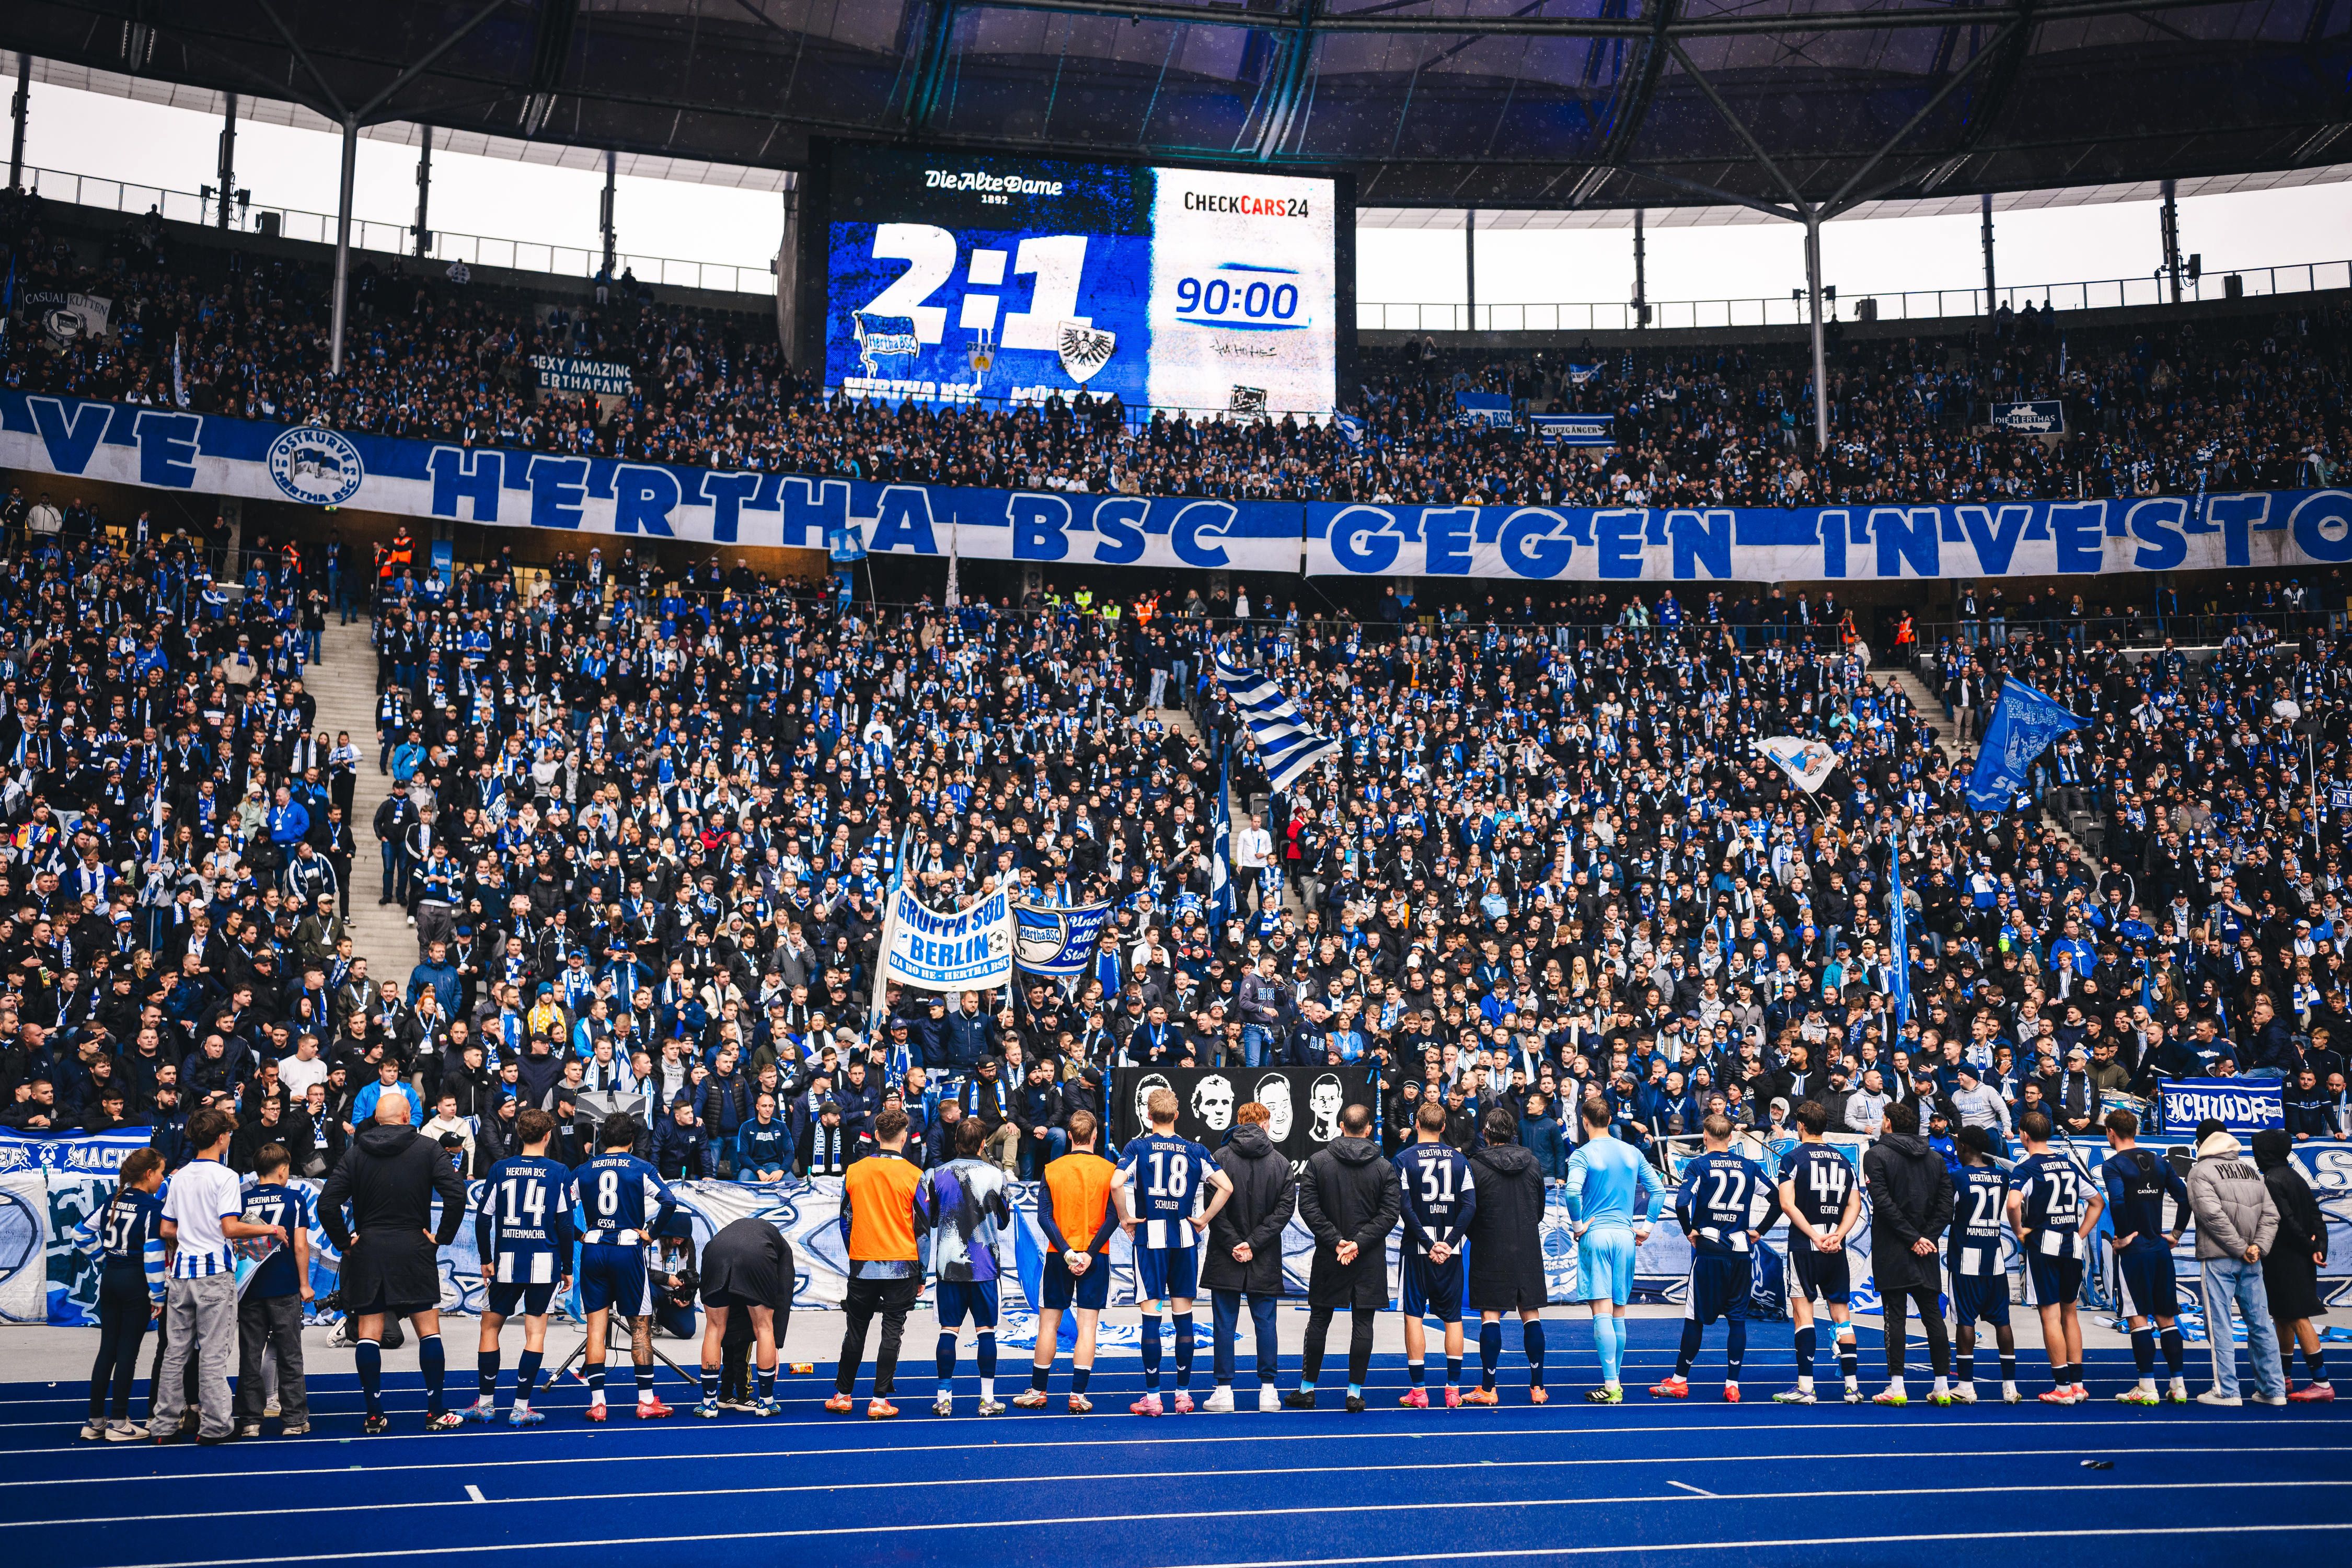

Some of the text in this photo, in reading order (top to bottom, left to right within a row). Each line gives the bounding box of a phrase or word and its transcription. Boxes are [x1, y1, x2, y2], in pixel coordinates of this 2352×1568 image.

[982, 194, 1008, 204] 1892
[854, 223, 1093, 351] 2:1
[25, 291, 108, 315] CASUAL KUTTEN
[1175, 278, 1299, 319] 90:00
[541, 372, 633, 394] ERTHAFANS
[1493, 411, 1512, 426] BSC
[1547, 423, 1597, 434] KIEZGÄNGER
[278, 431, 355, 463] OSTKURVE
[275, 458, 356, 476] 18 92
[16, 396, 203, 488] VE
[425, 444, 939, 555] HERTHA
[1006, 492, 1239, 567] BSC
[1325, 504, 1736, 580] GEGEN
[275, 471, 356, 502] HERTHA BSC
[897, 890, 1005, 938] GRUPPA SÜD
[1020, 926, 1060, 941] Hertha BSC
[909, 932, 989, 967] BERLIN
[891, 954, 903, 969] HA
[905, 964, 920, 975] HO
[921, 969, 937, 979] HE
[944, 963, 990, 981] HERTHA
[990, 958, 1010, 972] BSC
[1151, 1142, 1186, 1154] HERTHA BSC
[1417, 1148, 1442, 1158] HERTHA
[1808, 1150, 1843, 1161] HERTHA BSC
[72, 1147, 135, 1169] MACH
[592, 1159, 631, 1169] HERTHA BSC
[1732, 1161, 1743, 1169] BSC
[2040, 1161, 2071, 1172] HERTHA BSC
[505, 1167, 547, 1178] HERTHA BSC
[1148, 1152, 1188, 1197] 18
[1418, 1158, 1455, 1202] 31
[1810, 1160, 1847, 1204] 44
[1968, 1174, 2003, 1184] HERTHA BSC
[2213, 1163, 2261, 1182] PEGADOR
[248, 1195, 270, 1205] HERTHA
[597, 1170, 618, 1216] 8
[1708, 1169, 1746, 1212] 22
[2043, 1171, 2078, 1214] 23
[111, 1201, 138, 1212] HRTHA BSC
[501, 1179, 546, 1227] 14
[1155, 1200, 1179, 1210] SCHULER
[1429, 1204, 1448, 1214] DÁRDAI
[1969, 1184, 2001, 1227] 21
[1712, 1212, 1737, 1223] WINKLER
[2050, 1215, 2077, 1225] EICHHORN
[103, 1210, 137, 1250] 37
[1967, 1227, 1994, 1237] MAMUZAH
